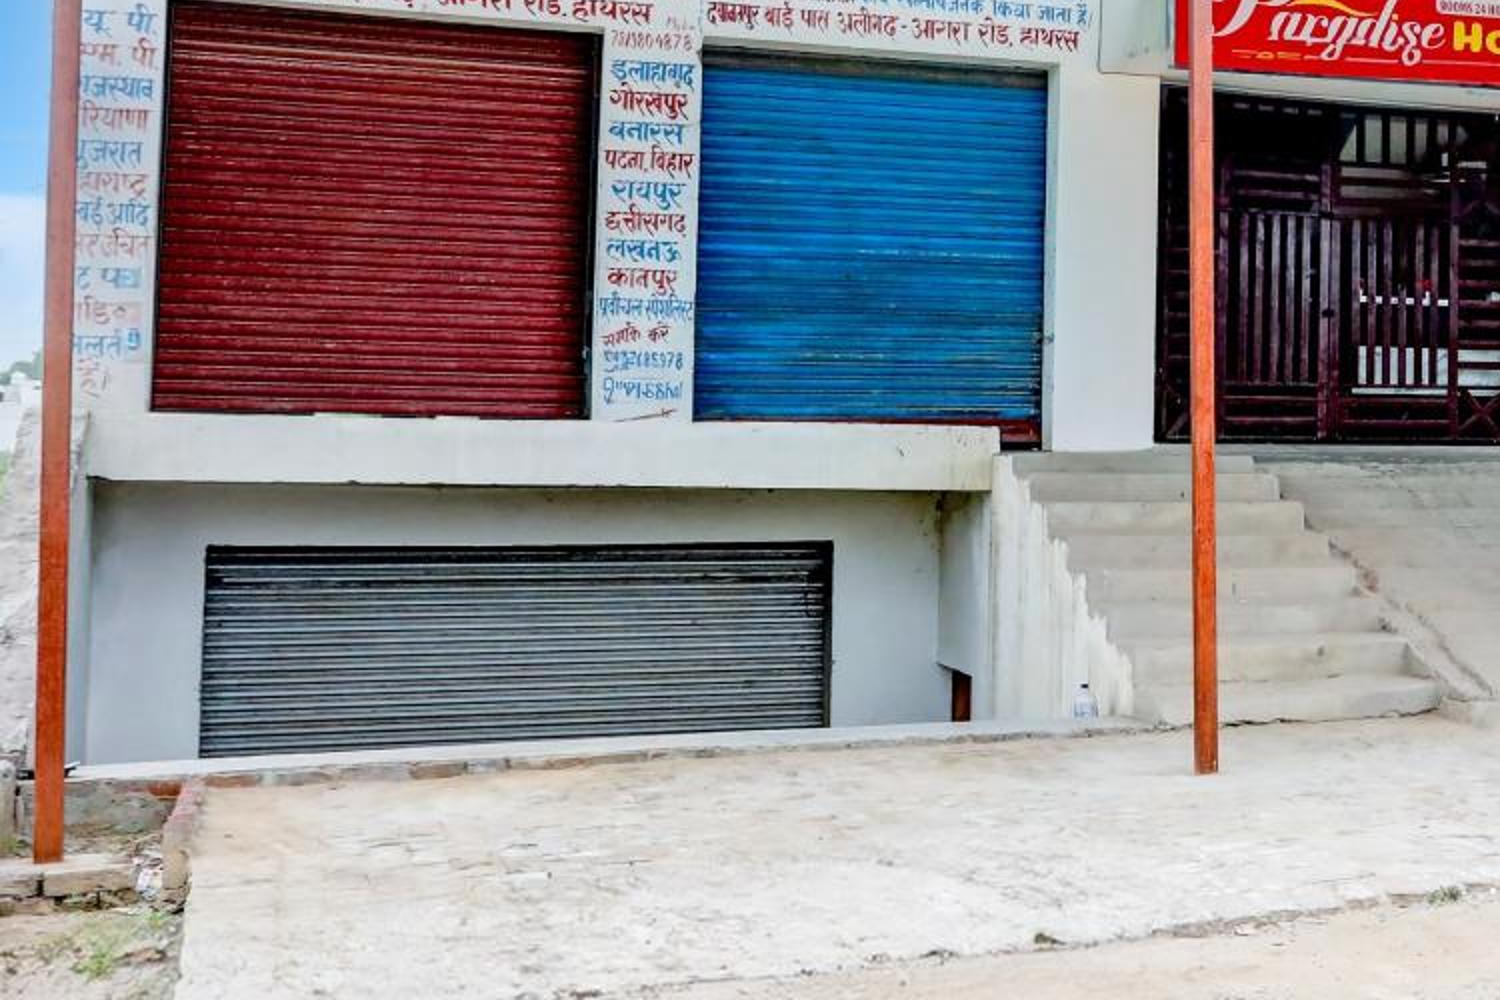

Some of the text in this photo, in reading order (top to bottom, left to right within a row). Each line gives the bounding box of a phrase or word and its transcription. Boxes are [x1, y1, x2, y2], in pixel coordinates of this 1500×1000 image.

[1474, 3, 1487, 15] 24
[1020, 26, 1081, 53] हाथरस
[610, 59, 695, 92] इलाहाबाद
[609, 82, 690, 120] गोरखपुर
[608, 120, 686, 144] बनारस
[610, 180, 687, 210] रायपुर
[606, 239, 681, 263] लखनऊ
[607, 267, 678, 297] कानपुर
